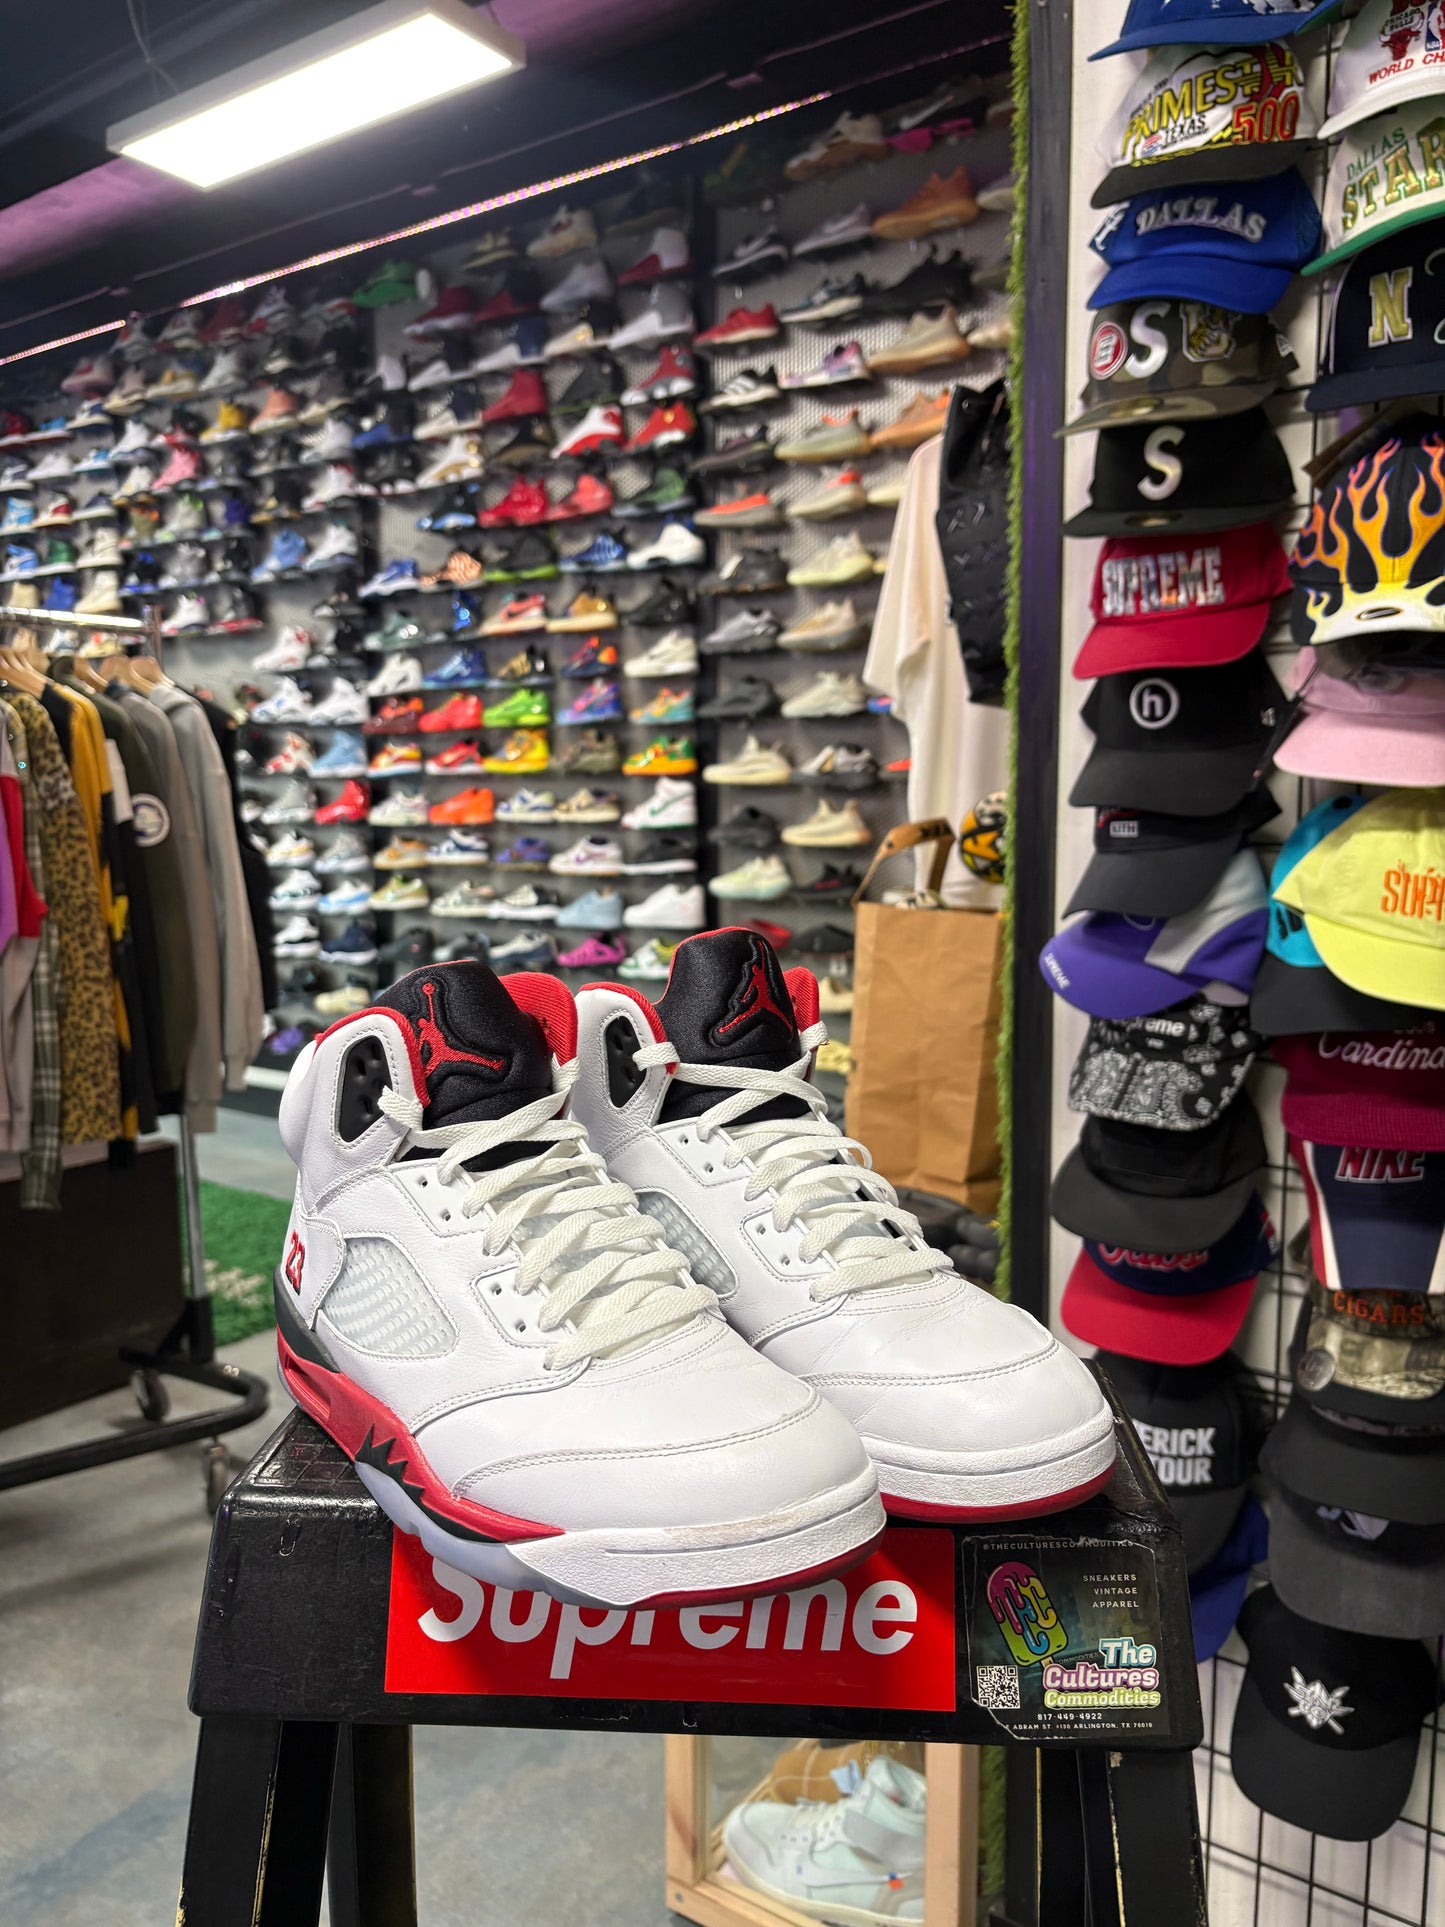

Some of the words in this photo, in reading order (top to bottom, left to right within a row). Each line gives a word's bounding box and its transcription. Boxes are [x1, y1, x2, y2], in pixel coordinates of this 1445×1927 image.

[1369, 58, 1414, 84] WORLD
[1163, 114, 1206, 146] TEXAS
[1232, 91, 1299, 145] 500
[1347, 127, 1405, 181] DALLAS
[1136, 198, 1267, 243] DALLAS
[1368, 267, 1413, 348] N
[1125, 301, 1171, 378] S
[1137, 425, 1185, 500] S
[1102, 546, 1225, 618] SUPREME
[1111, 1016, 1186, 1038] preme
[1335, 1147, 1426, 1183] NIKE
[285, 1229, 305, 1296] 23
[1333, 1290, 1425, 1326] CIGARS
[1083, 1573, 1137, 1582] SNEAKERS
[1094, 1587, 1138, 1595] VINTAGE
[1092, 1600, 1139, 1609] APPAREL
[1101, 1639, 1155, 1666] The
[1045, 1663, 1158, 1689] Cultures
[1046, 1687, 1160, 1708] Commodities
[1037, 1712, 1103, 1721] 817-449-4922
